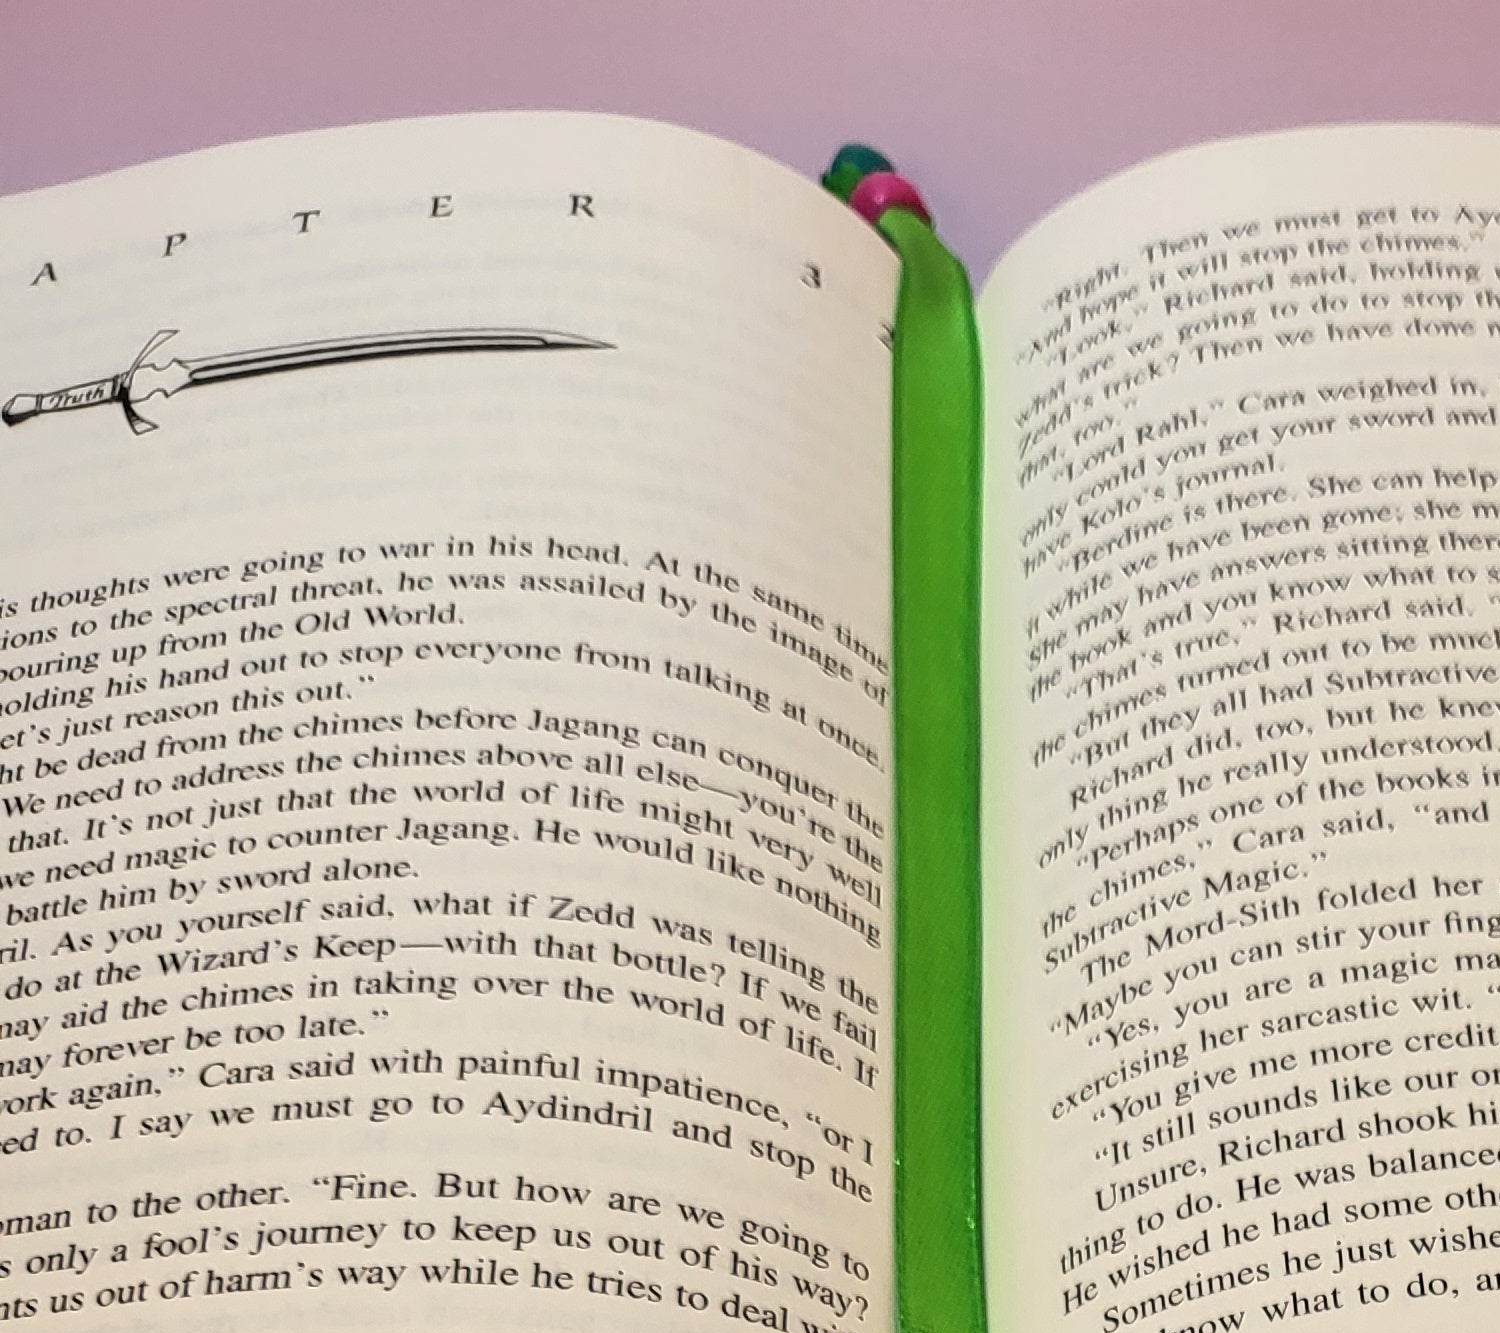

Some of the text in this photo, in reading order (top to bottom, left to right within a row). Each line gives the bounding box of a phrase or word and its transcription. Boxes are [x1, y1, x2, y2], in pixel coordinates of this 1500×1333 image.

[50, 384, 105, 409] Truth
[30, 535, 889, 677] thoughts were going to war in his head. At the same time
[1069, 743, 1173, 812] Richard
[1185, 726, 1242, 759] did,
[1255, 717, 1314, 743] too,
[1325, 705, 1375, 729] but
[1387, 699, 1425, 723] he
[8, 779, 881, 910] that. It’s not just that the world of life might very well
[1095, 1159, 1207, 1212] Unsure,
[1217, 1116, 1346, 1167] Richard
[1358, 1104, 1457, 1139] shook
